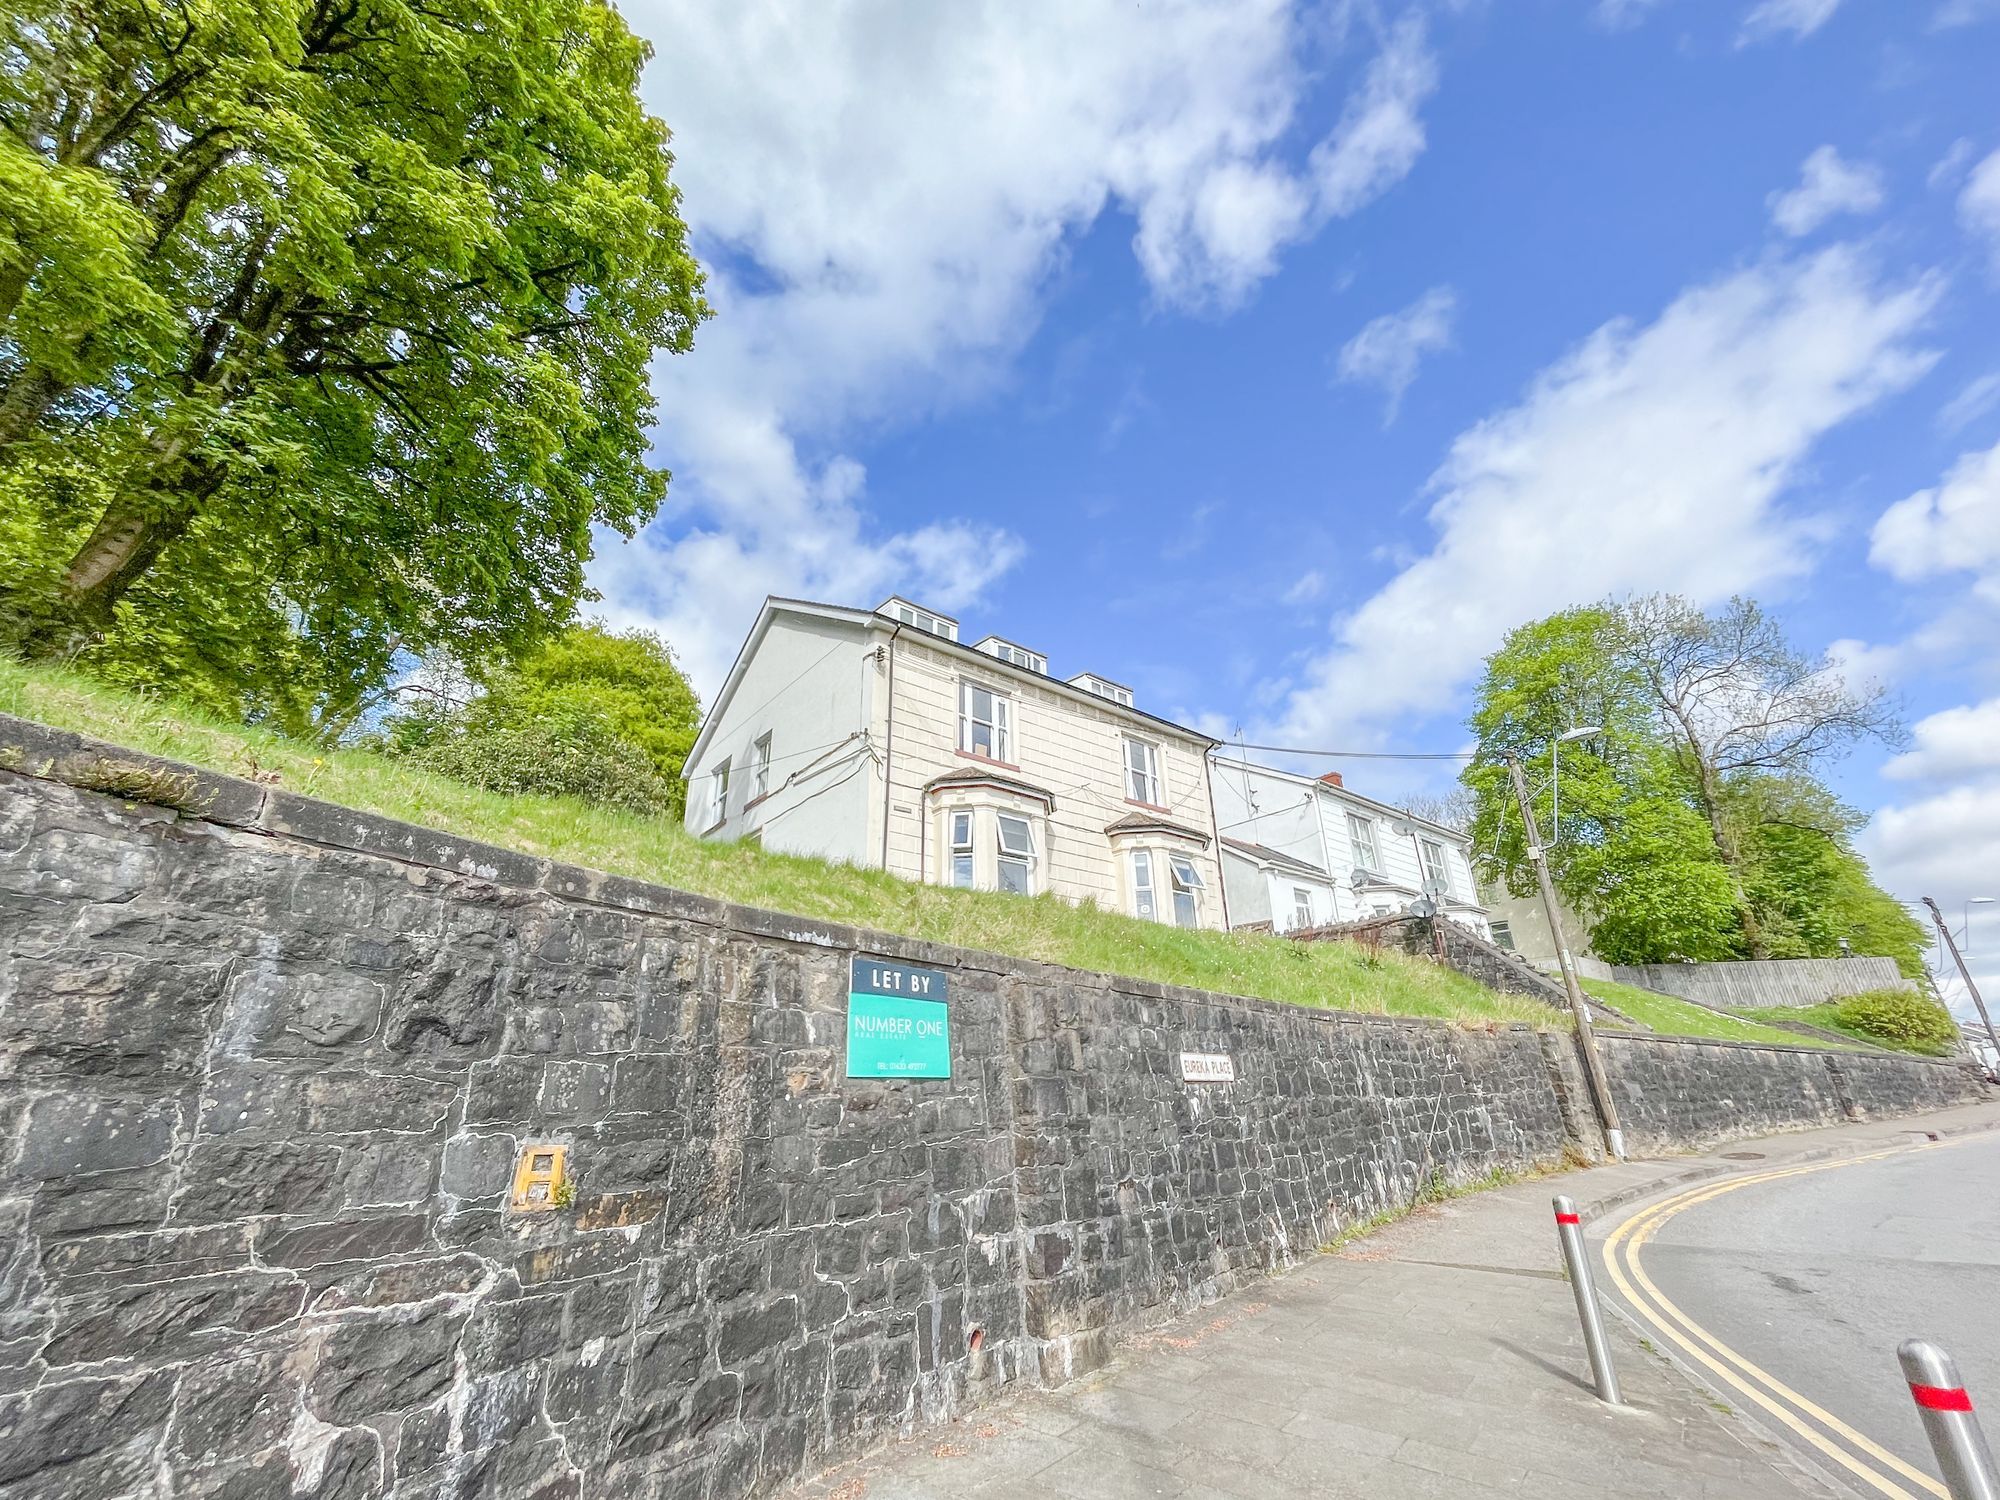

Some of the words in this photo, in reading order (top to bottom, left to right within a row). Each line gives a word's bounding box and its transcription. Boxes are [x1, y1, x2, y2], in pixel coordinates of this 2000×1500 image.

[872, 968, 902, 990] LET
[911, 974, 930, 994] BY
[854, 1015, 912, 1034] NUMBER
[916, 1020, 943, 1038] ONE
[1184, 1060, 1210, 1074] EUREKA
[1211, 1061, 1231, 1075] PLACE
